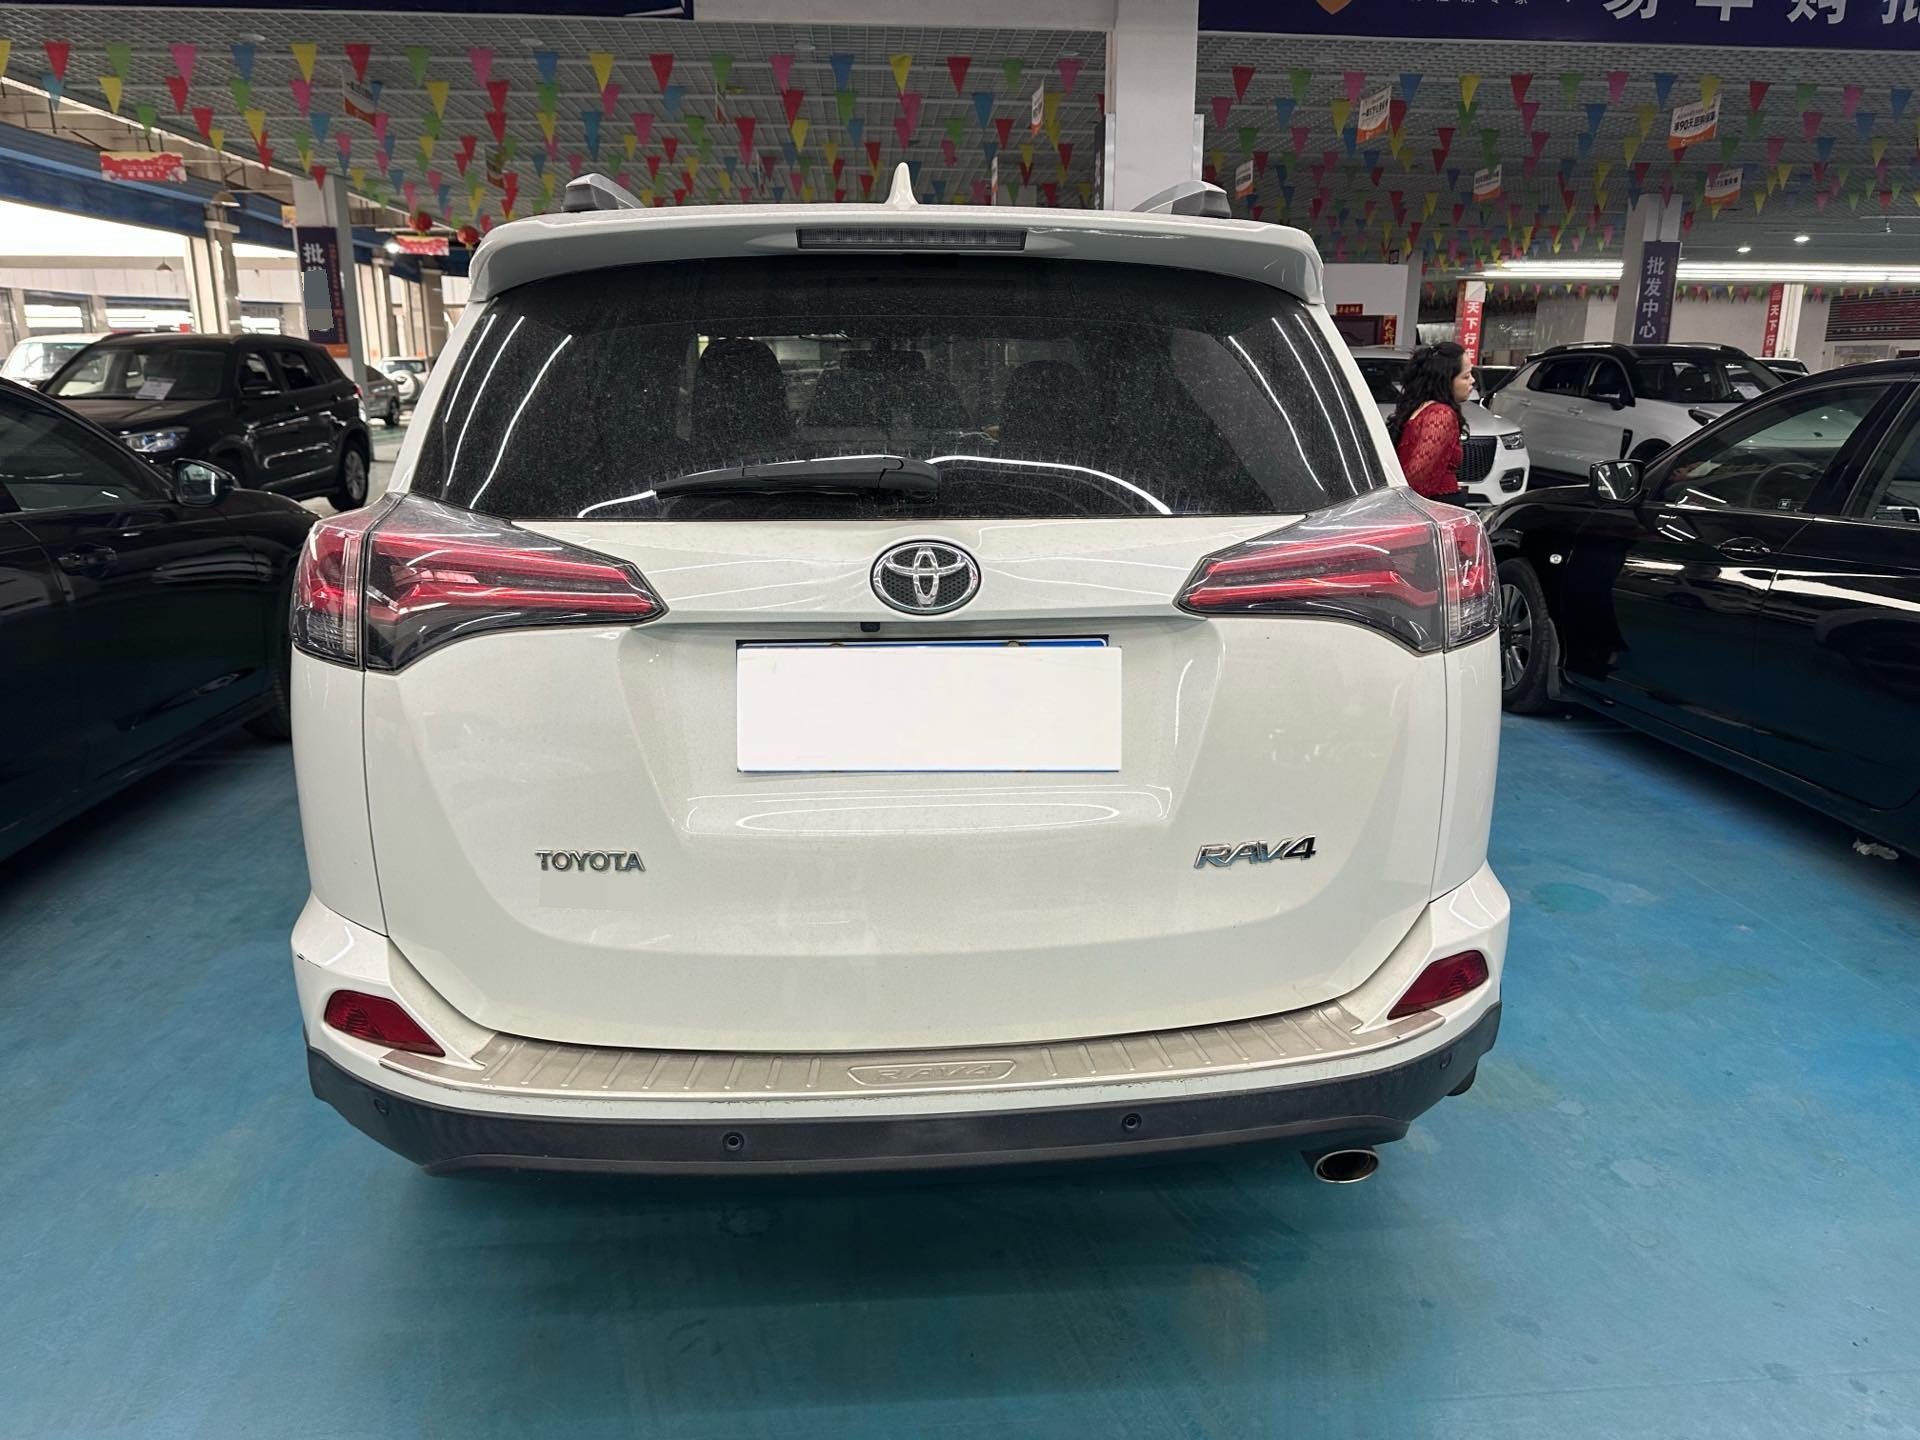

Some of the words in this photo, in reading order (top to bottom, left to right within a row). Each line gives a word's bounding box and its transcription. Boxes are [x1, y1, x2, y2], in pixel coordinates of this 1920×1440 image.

[1639, 256, 1665, 338] 批发中心
[535, 850, 646, 873] TOYOTA
[1194, 834, 1317, 869] RAV4
[878, 1064, 992, 1081] RAV4
